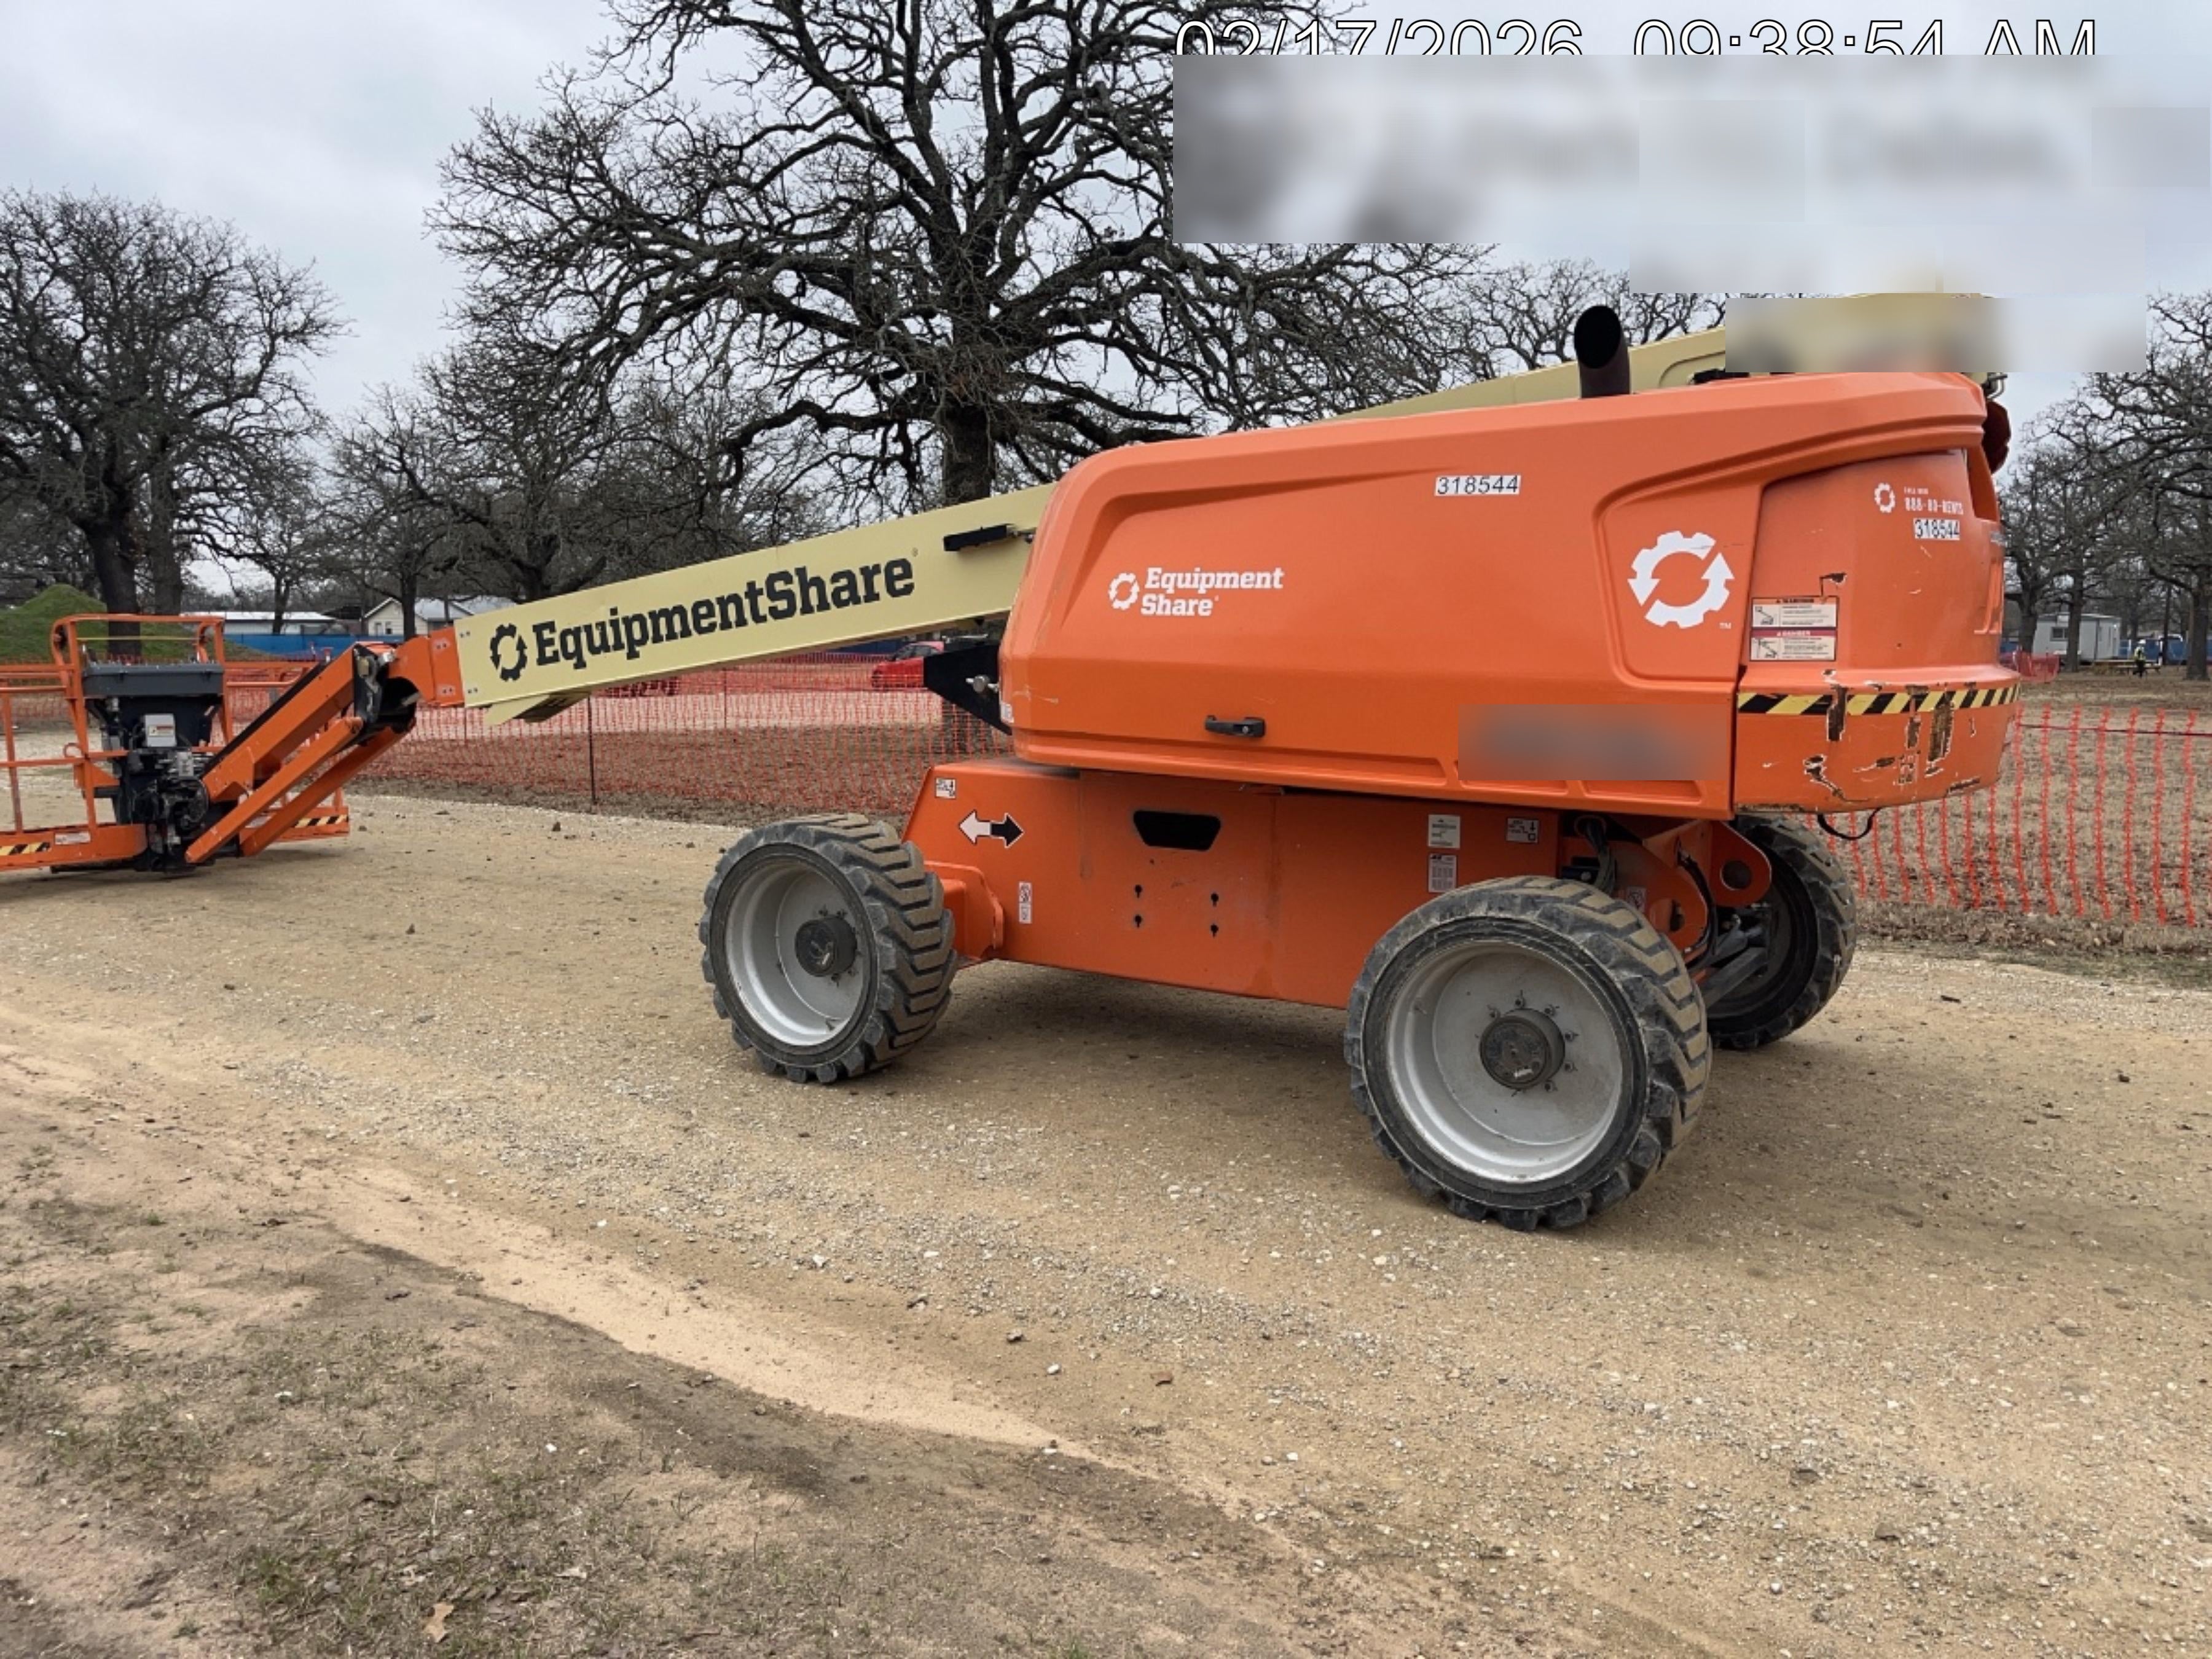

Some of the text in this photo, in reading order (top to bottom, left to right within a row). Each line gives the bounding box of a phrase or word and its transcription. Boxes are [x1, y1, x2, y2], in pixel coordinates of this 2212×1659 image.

[1437, 475, 1518, 495] 318544
[1914, 519, 1959, 539] 318544
[1144, 567, 1285, 594] Equipment
[532, 557, 916, 670] EquipmentShare
[1140, 593, 1214, 616] Share
